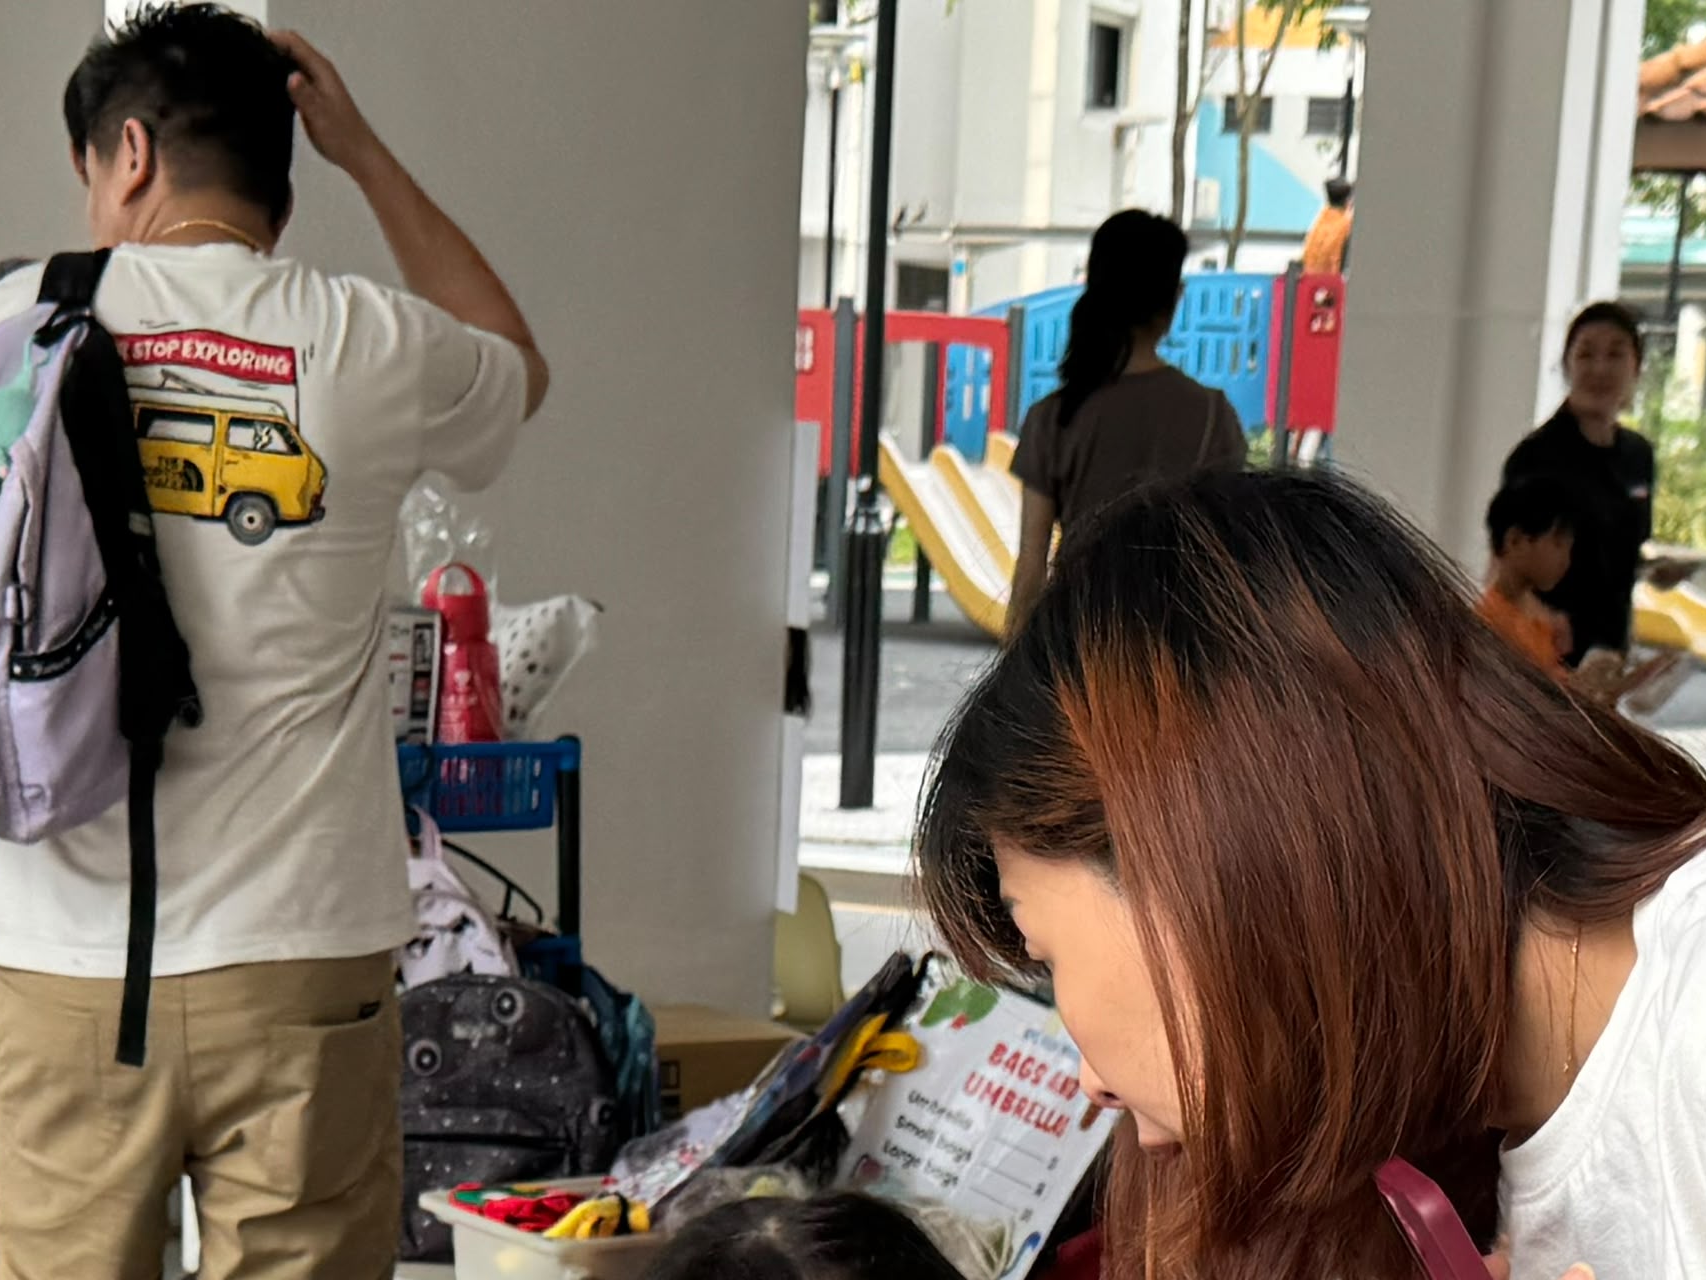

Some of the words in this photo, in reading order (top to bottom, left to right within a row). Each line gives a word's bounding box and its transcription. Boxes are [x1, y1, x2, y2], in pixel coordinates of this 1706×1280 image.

[132, 340, 181, 360] STOP
[181, 340, 292, 377] EXPLORING
[989, 1043, 1048, 1087] BAGS
